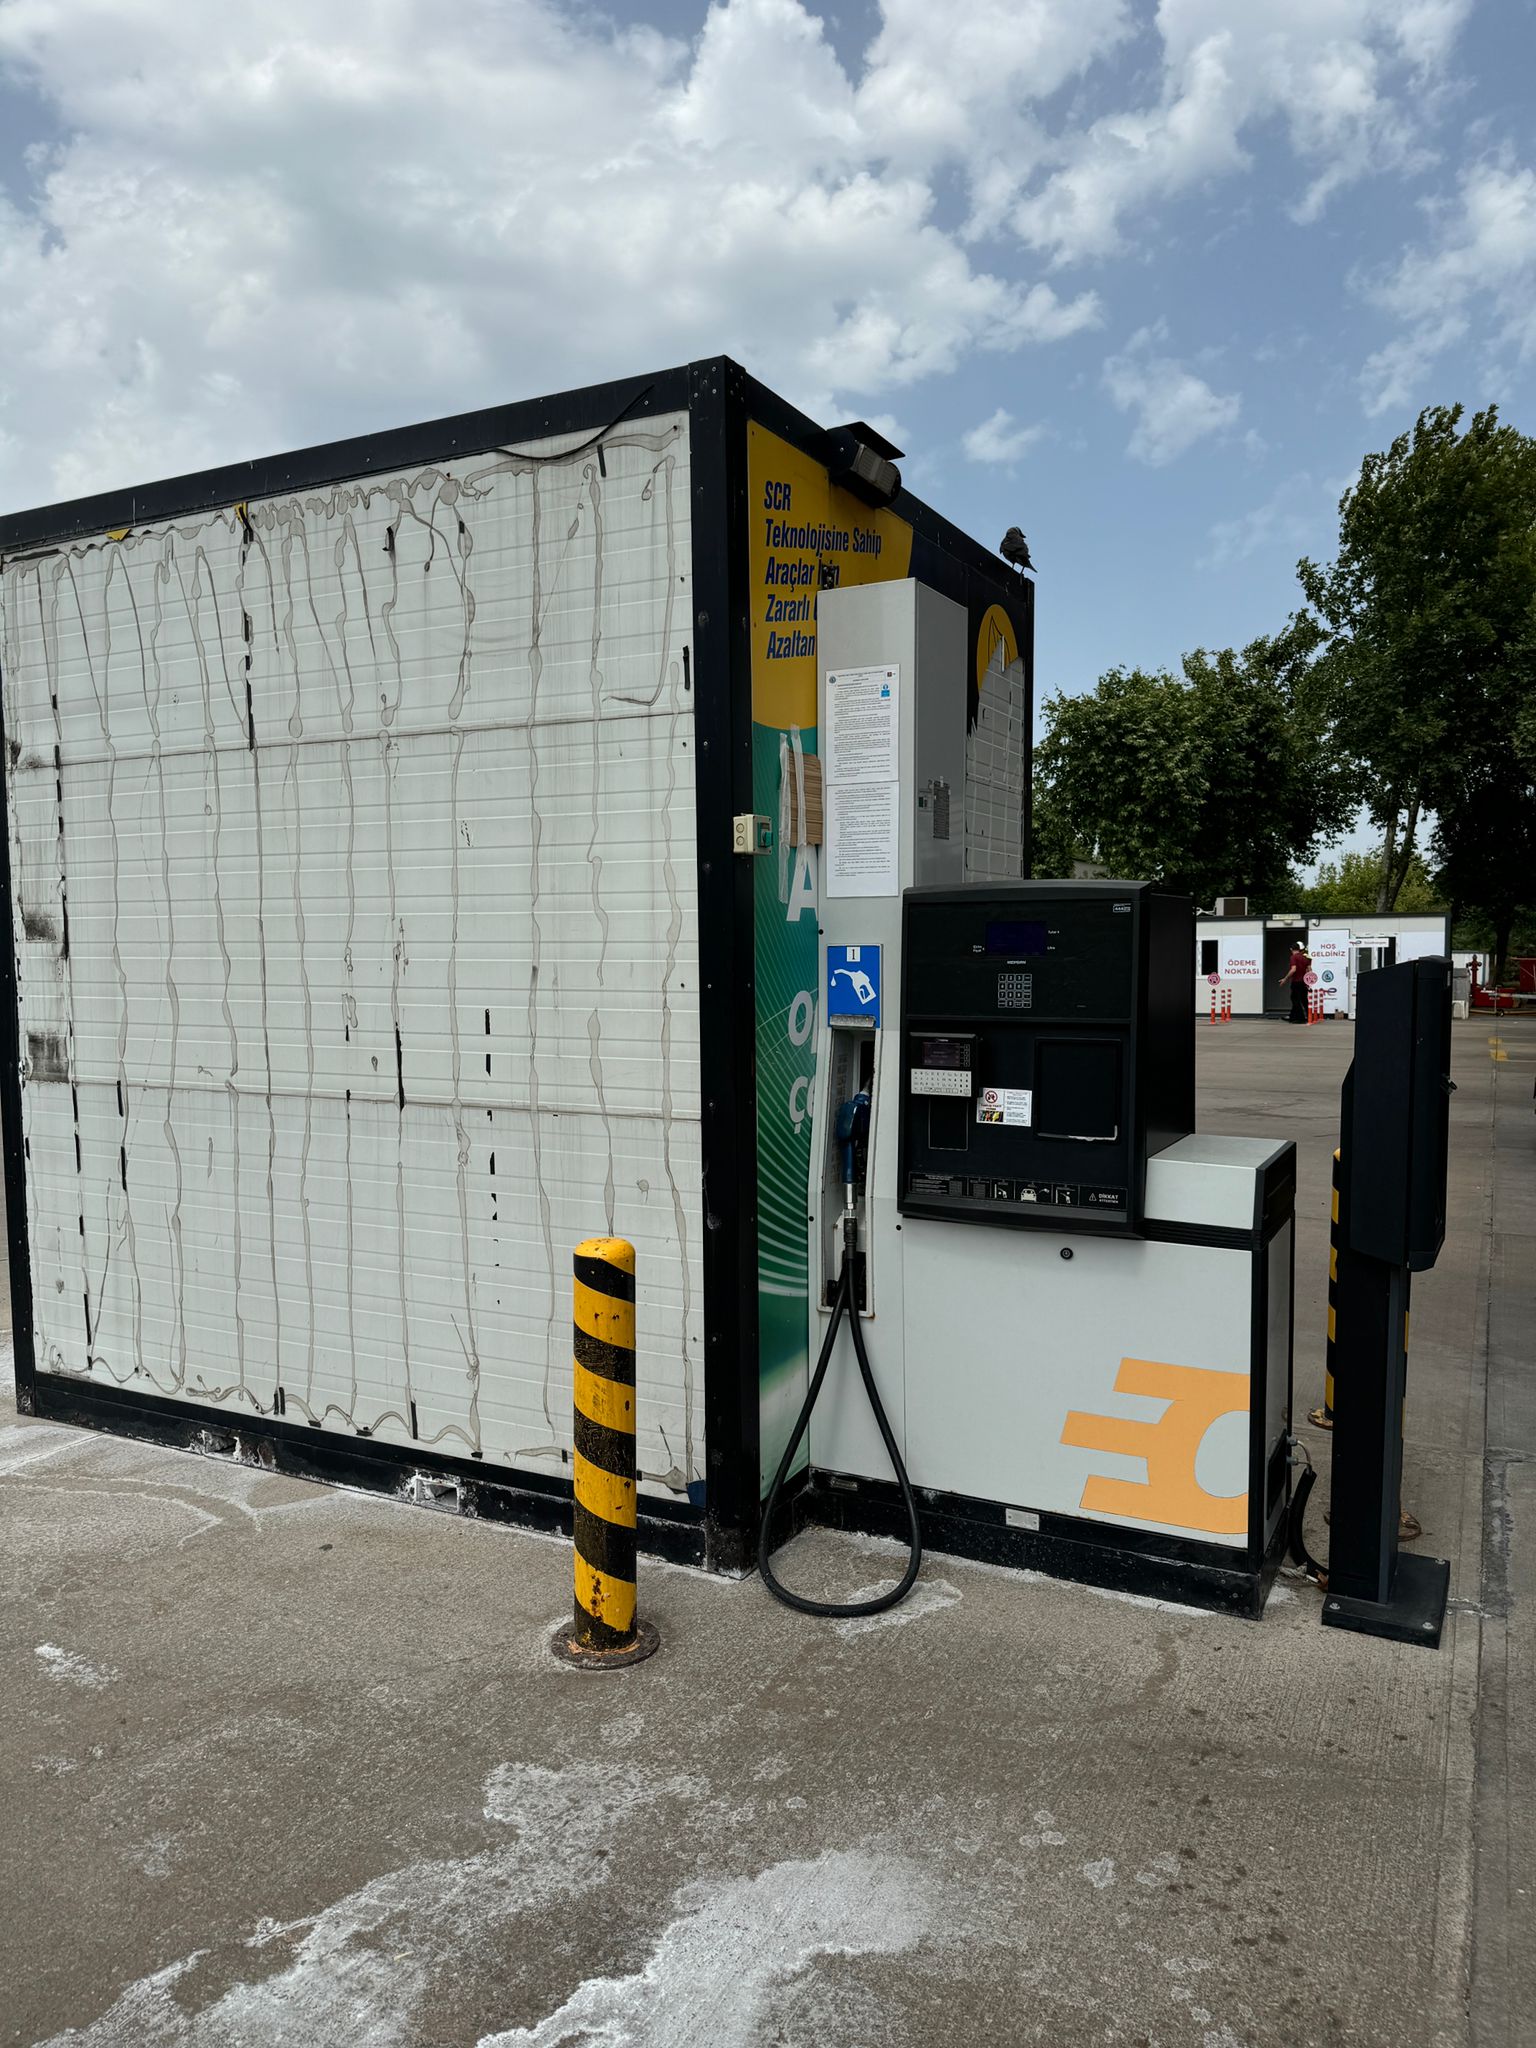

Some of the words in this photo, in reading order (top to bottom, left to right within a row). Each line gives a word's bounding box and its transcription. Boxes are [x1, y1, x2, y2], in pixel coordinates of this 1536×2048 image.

[764, 480, 791, 511] SCR
[765, 518, 849, 557] Teknolojisine
[852, 527, 882, 560] Sahip
[765, 556, 815, 592] Araçlar
[765, 593, 810, 622] Zararlı
[766, 629, 816, 659] Azaltan
